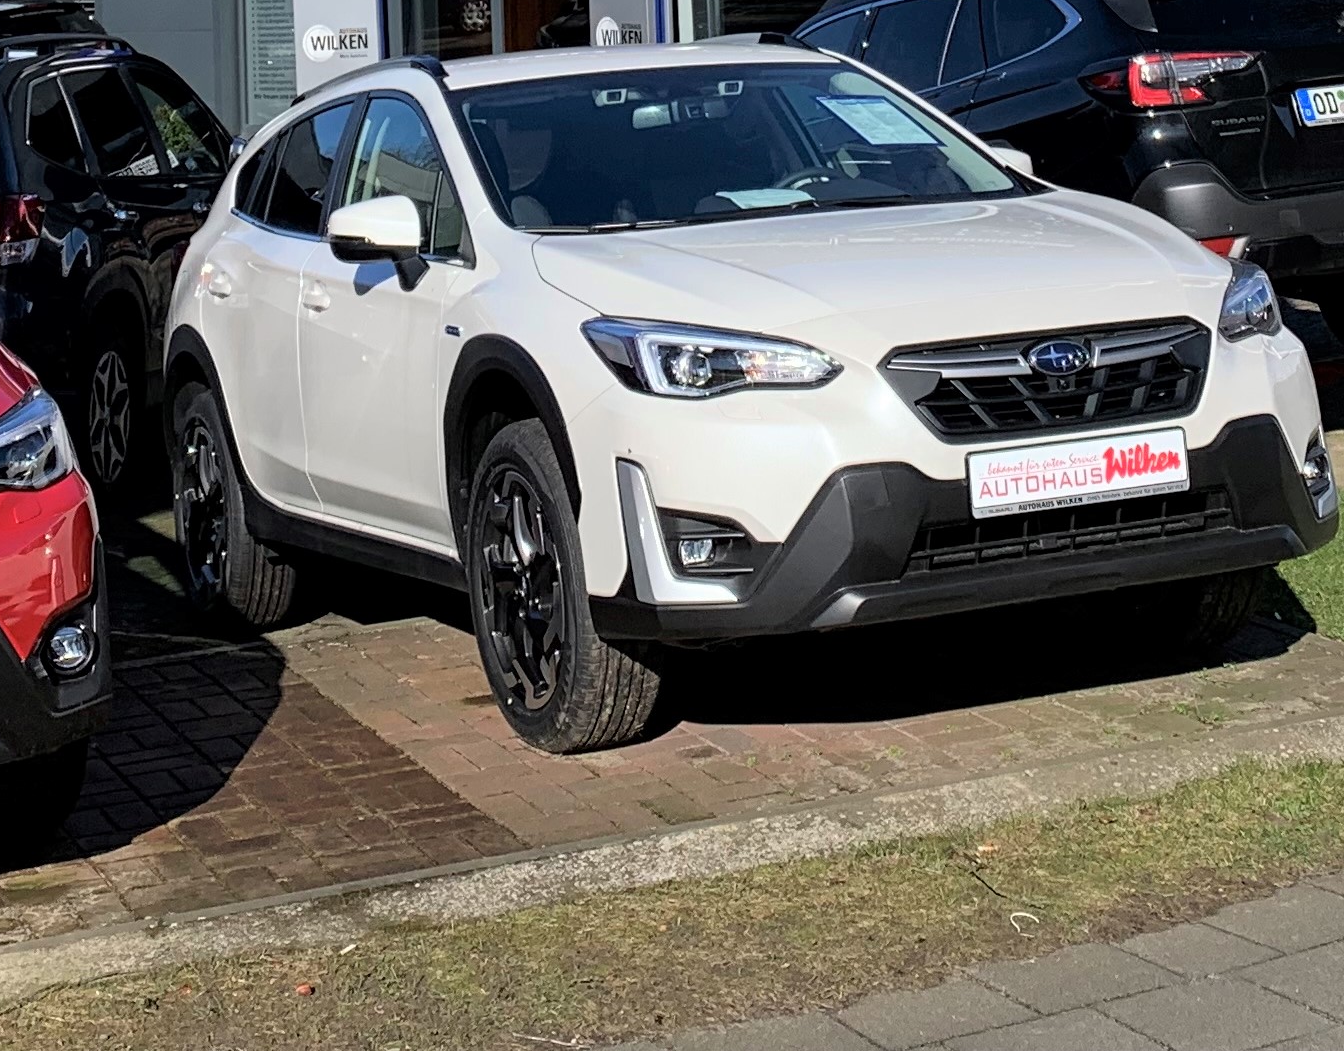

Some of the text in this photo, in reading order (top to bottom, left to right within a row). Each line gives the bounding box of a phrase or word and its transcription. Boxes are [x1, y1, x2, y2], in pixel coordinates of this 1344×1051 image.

[311, 34, 368, 51] WILKEN
[601, 29, 642, 45] WILKEN
[1313, 92, 1338, 115] OD
[1211, 115, 1265, 126] SUBARU
[979, 442, 1181, 499] AUTOHAUS Wilken
[1018, 500, 1055, 512] AUTOHAUS
[1056, 497, 1083, 507] WILKEN
